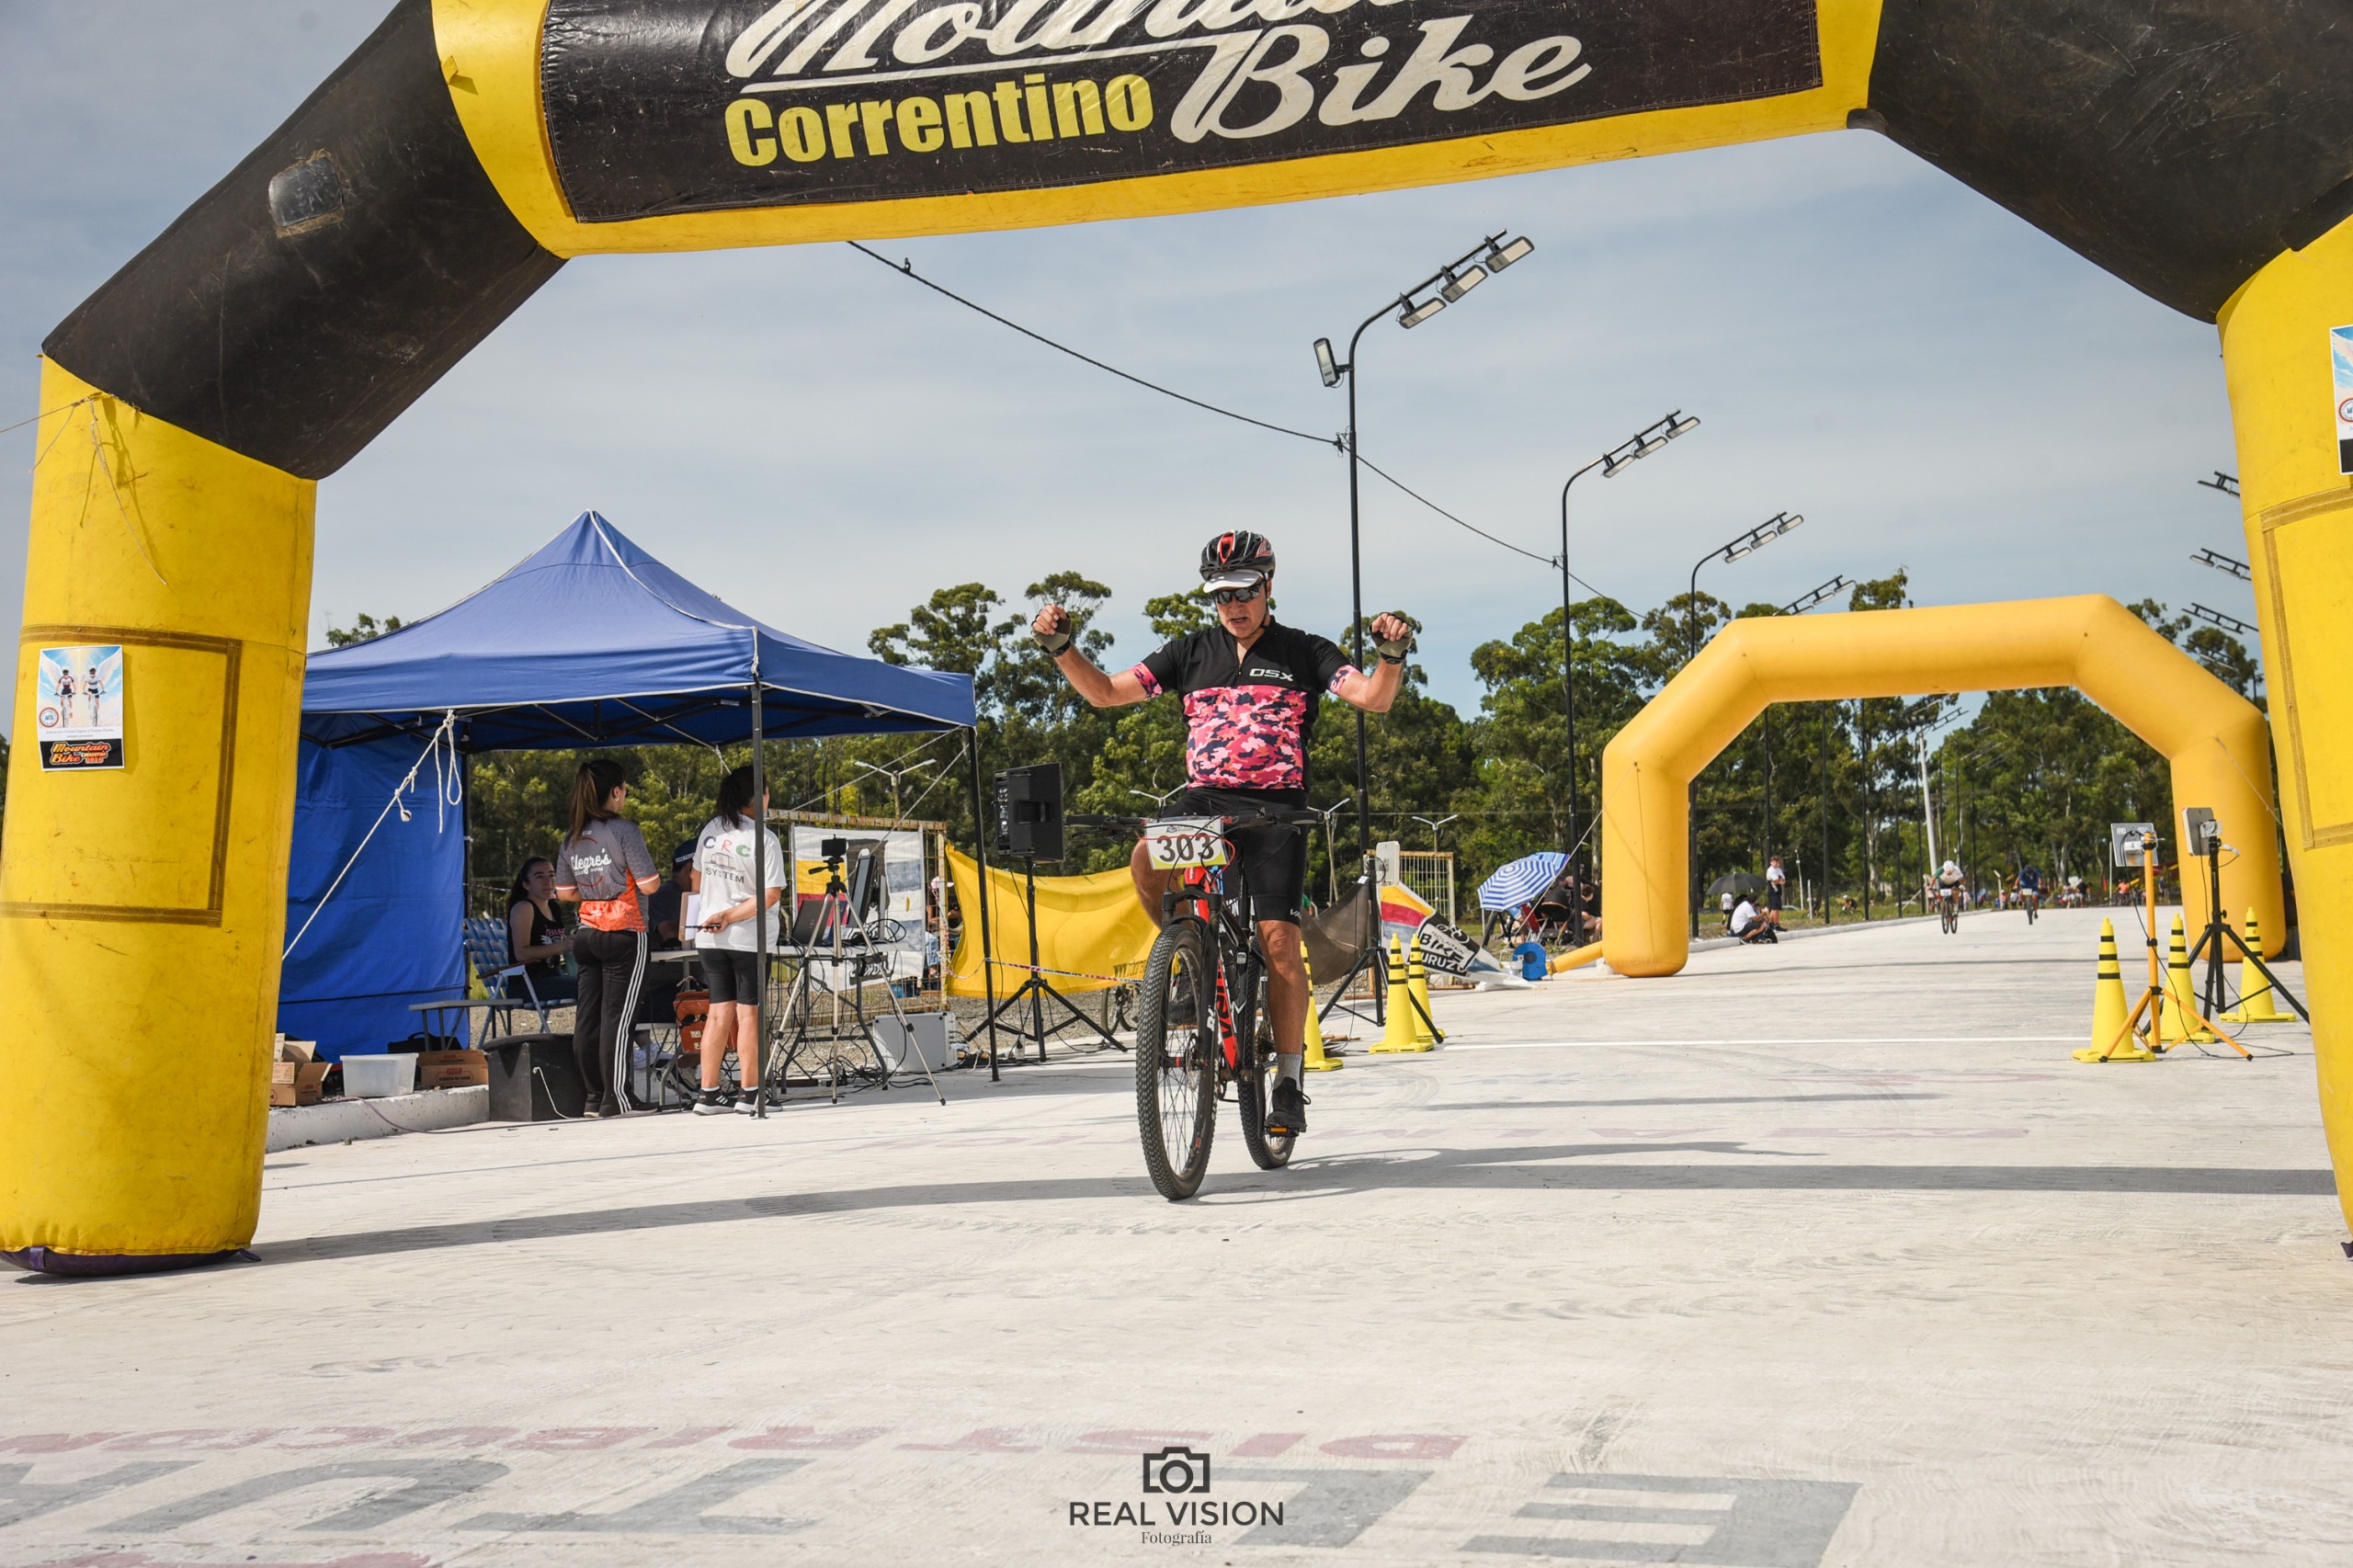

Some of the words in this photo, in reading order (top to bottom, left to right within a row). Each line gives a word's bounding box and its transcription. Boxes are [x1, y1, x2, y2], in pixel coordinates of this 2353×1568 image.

[1170, 15, 1593, 143] Bike
[724, 74, 1154, 166] Correntino
[1249, 668, 1293, 681] OSX
[51, 753, 82, 764] Bike
[52, 743, 109, 754] Mountain
[1156, 832, 1214, 862] 303
[1419, 932, 1464, 963] BIKE
[1431, 931, 1465, 955] MOUNTAIN
